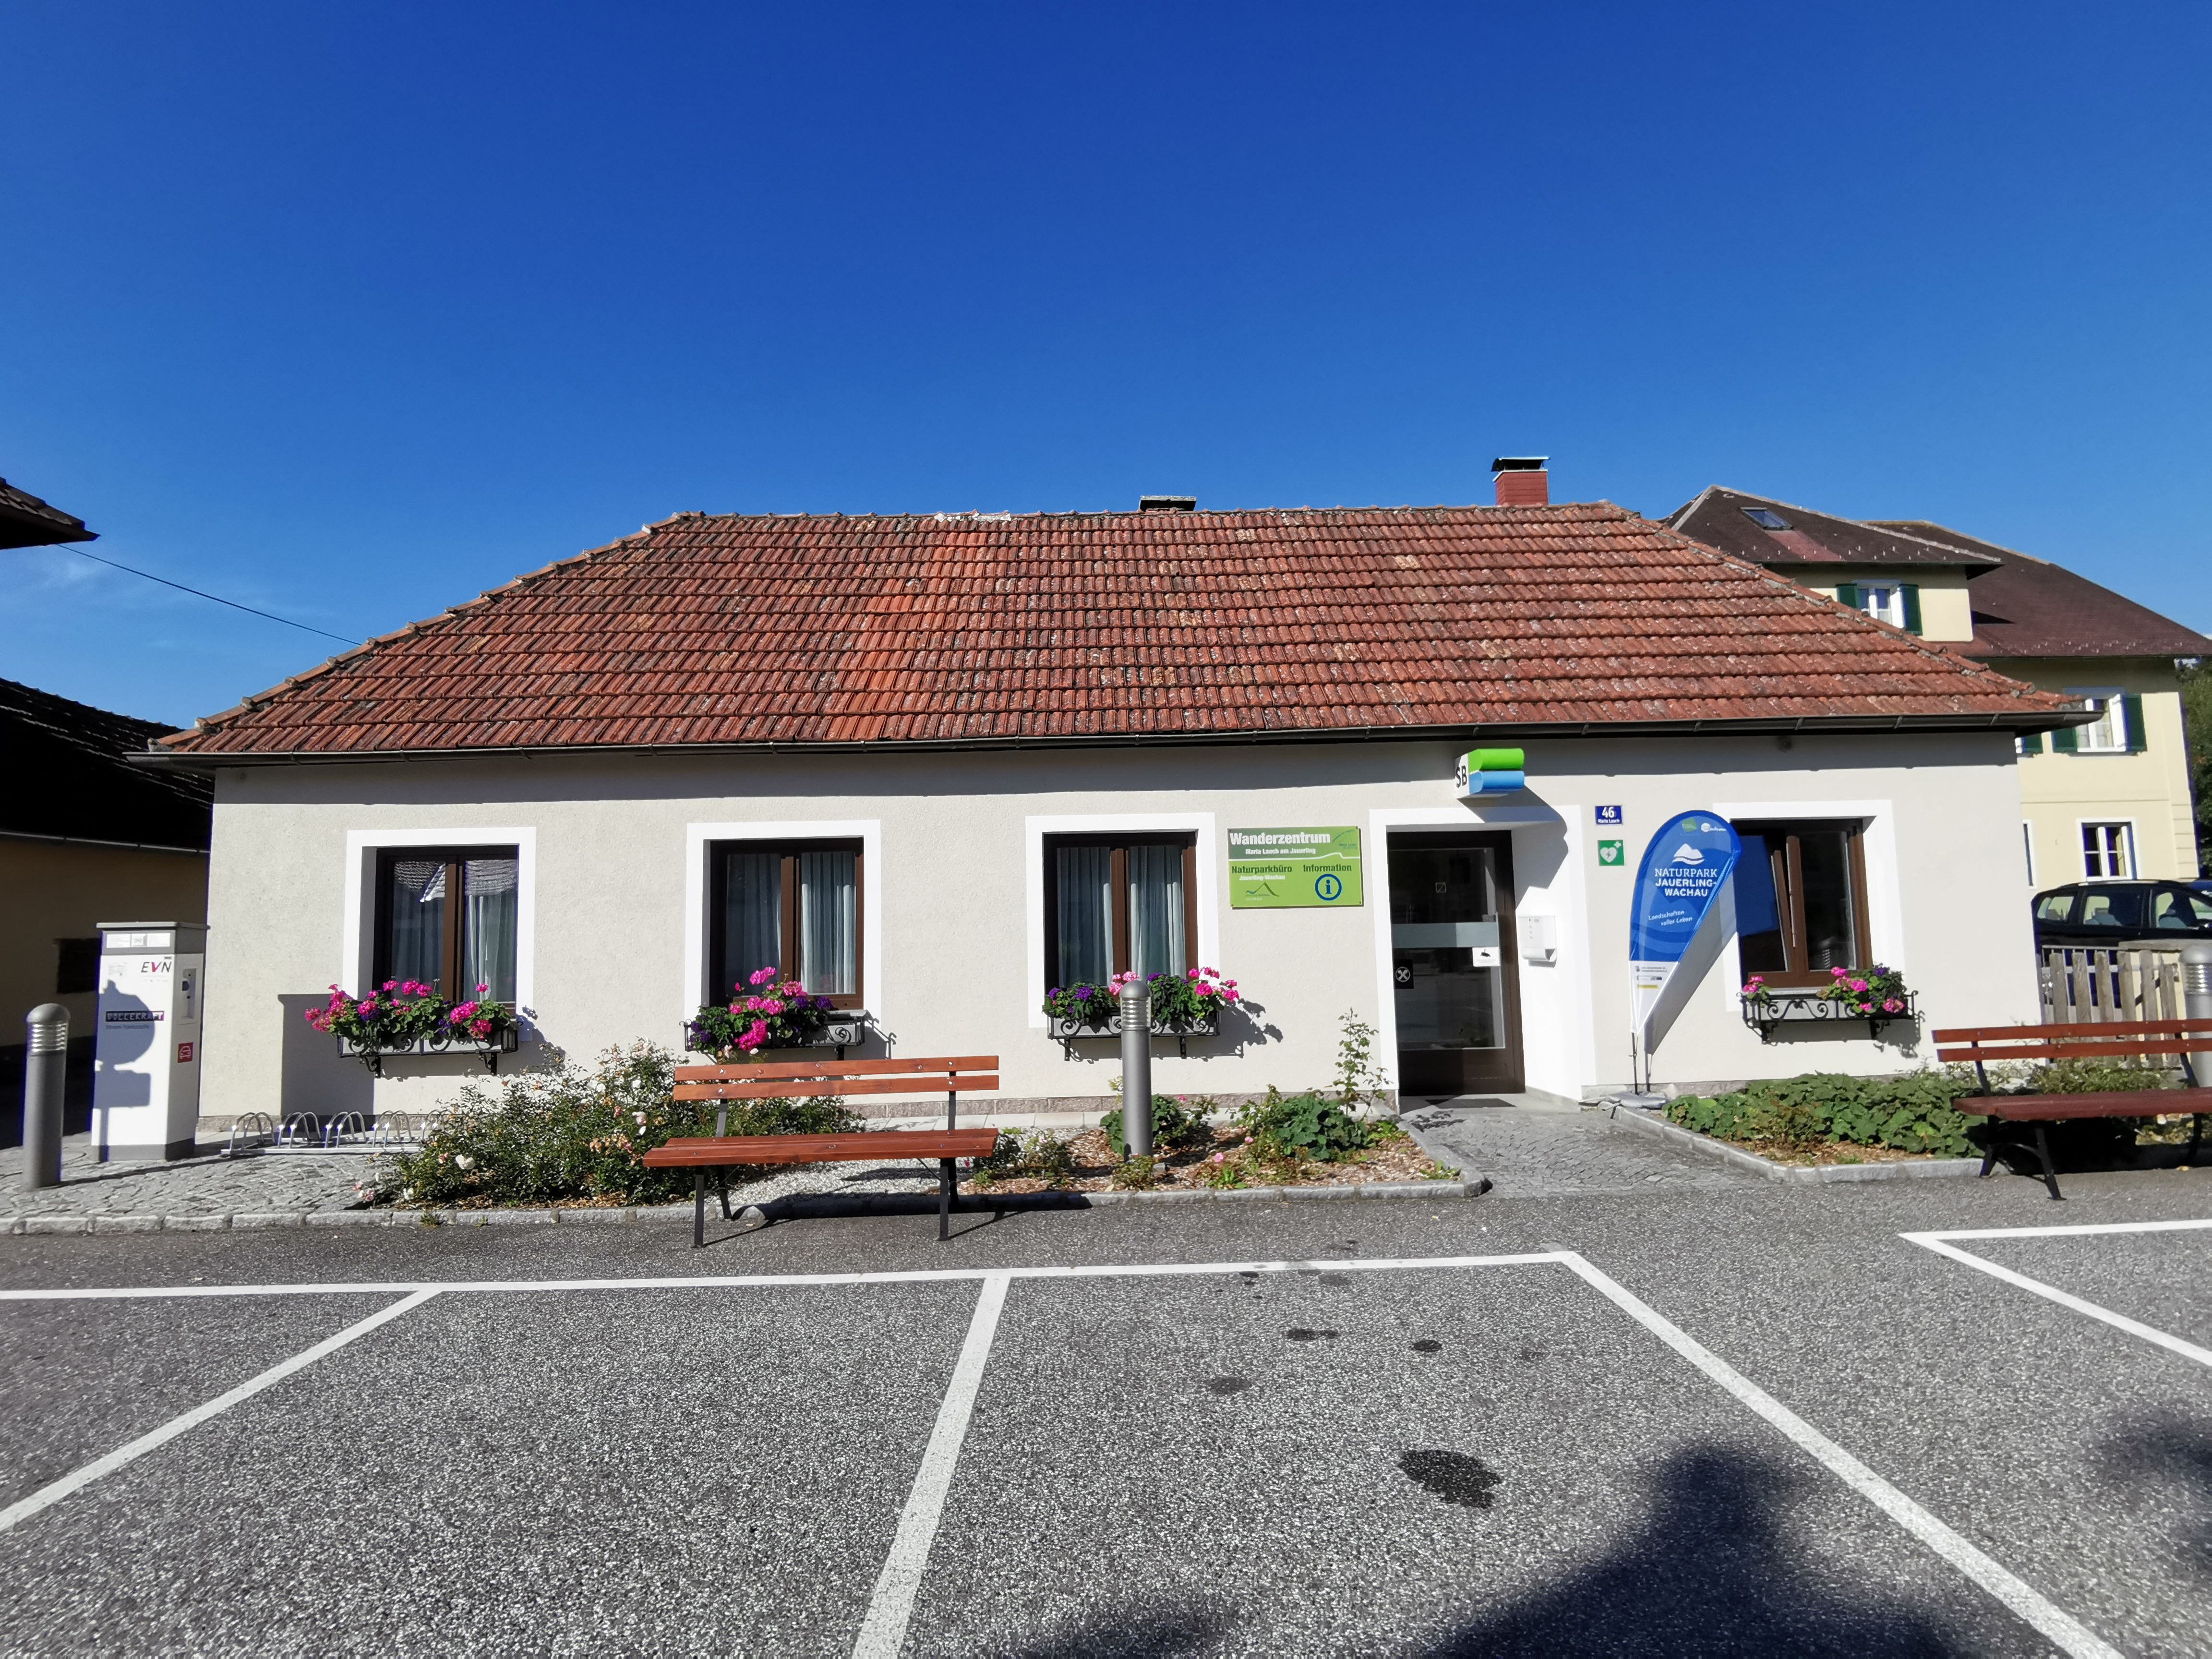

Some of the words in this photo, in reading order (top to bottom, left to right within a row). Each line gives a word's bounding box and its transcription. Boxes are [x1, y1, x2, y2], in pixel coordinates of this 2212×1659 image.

[1455, 765, 1467, 788] SB
[1602, 806, 1614, 818] 46
[1229, 831, 1330, 845] Wanderzentrum
[1231, 865, 1292, 874] Naturparkbüro
[1654, 868, 1718, 877] NATURPARK
[1655, 878, 1718, 887] JAUERLING-
[1664, 888, 1708, 897] WACHAU
[1648, 910, 1684, 921] Landschaften
[141, 962, 172, 973] EVN
